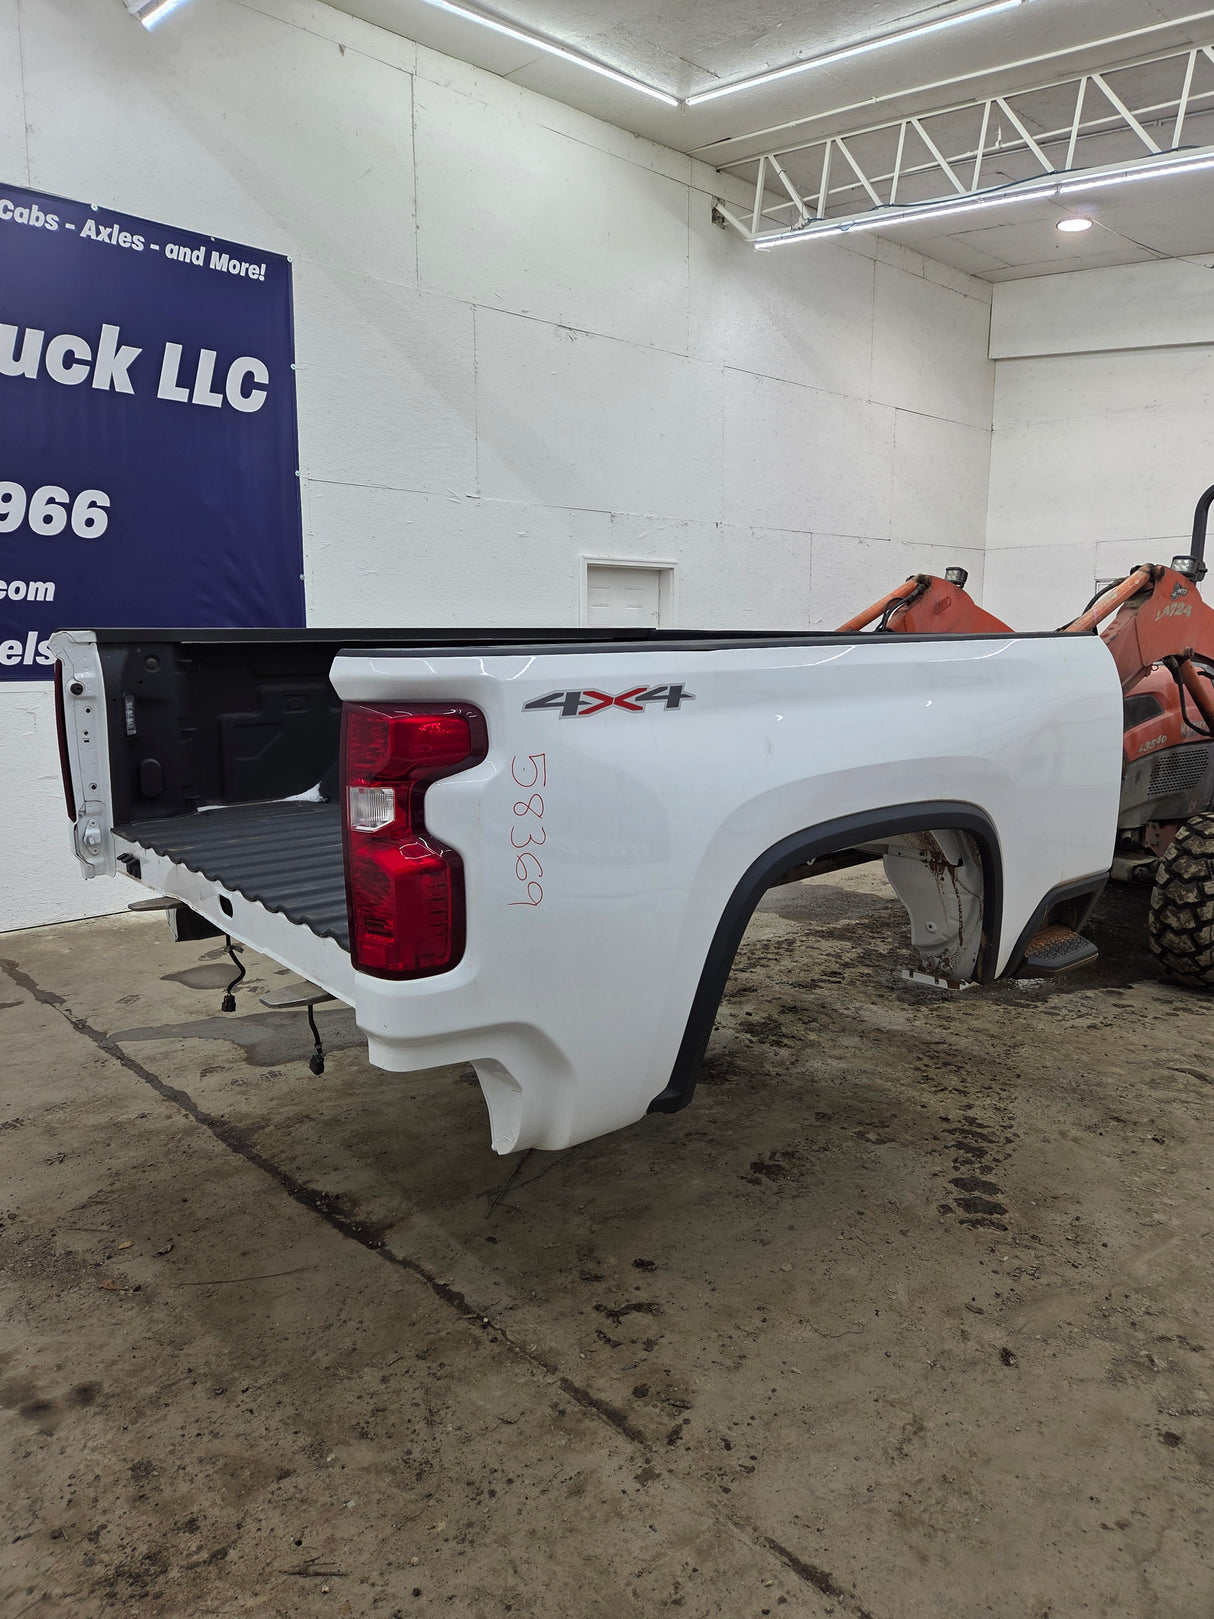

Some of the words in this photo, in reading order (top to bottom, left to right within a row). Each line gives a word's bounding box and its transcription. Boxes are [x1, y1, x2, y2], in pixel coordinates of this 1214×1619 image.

[0, 199, 60, 231] Cabs
[80, 219, 145, 251] Axles
[164, 243, 206, 267] and
[209, 251, 267, 282] More!
[0, 323, 143, 395] uck
[157, 341, 270, 413] LLC
[0, 480, 111, 539] 966
[0, 631, 57, 666] els
[506, 752, 547, 907] 58369
